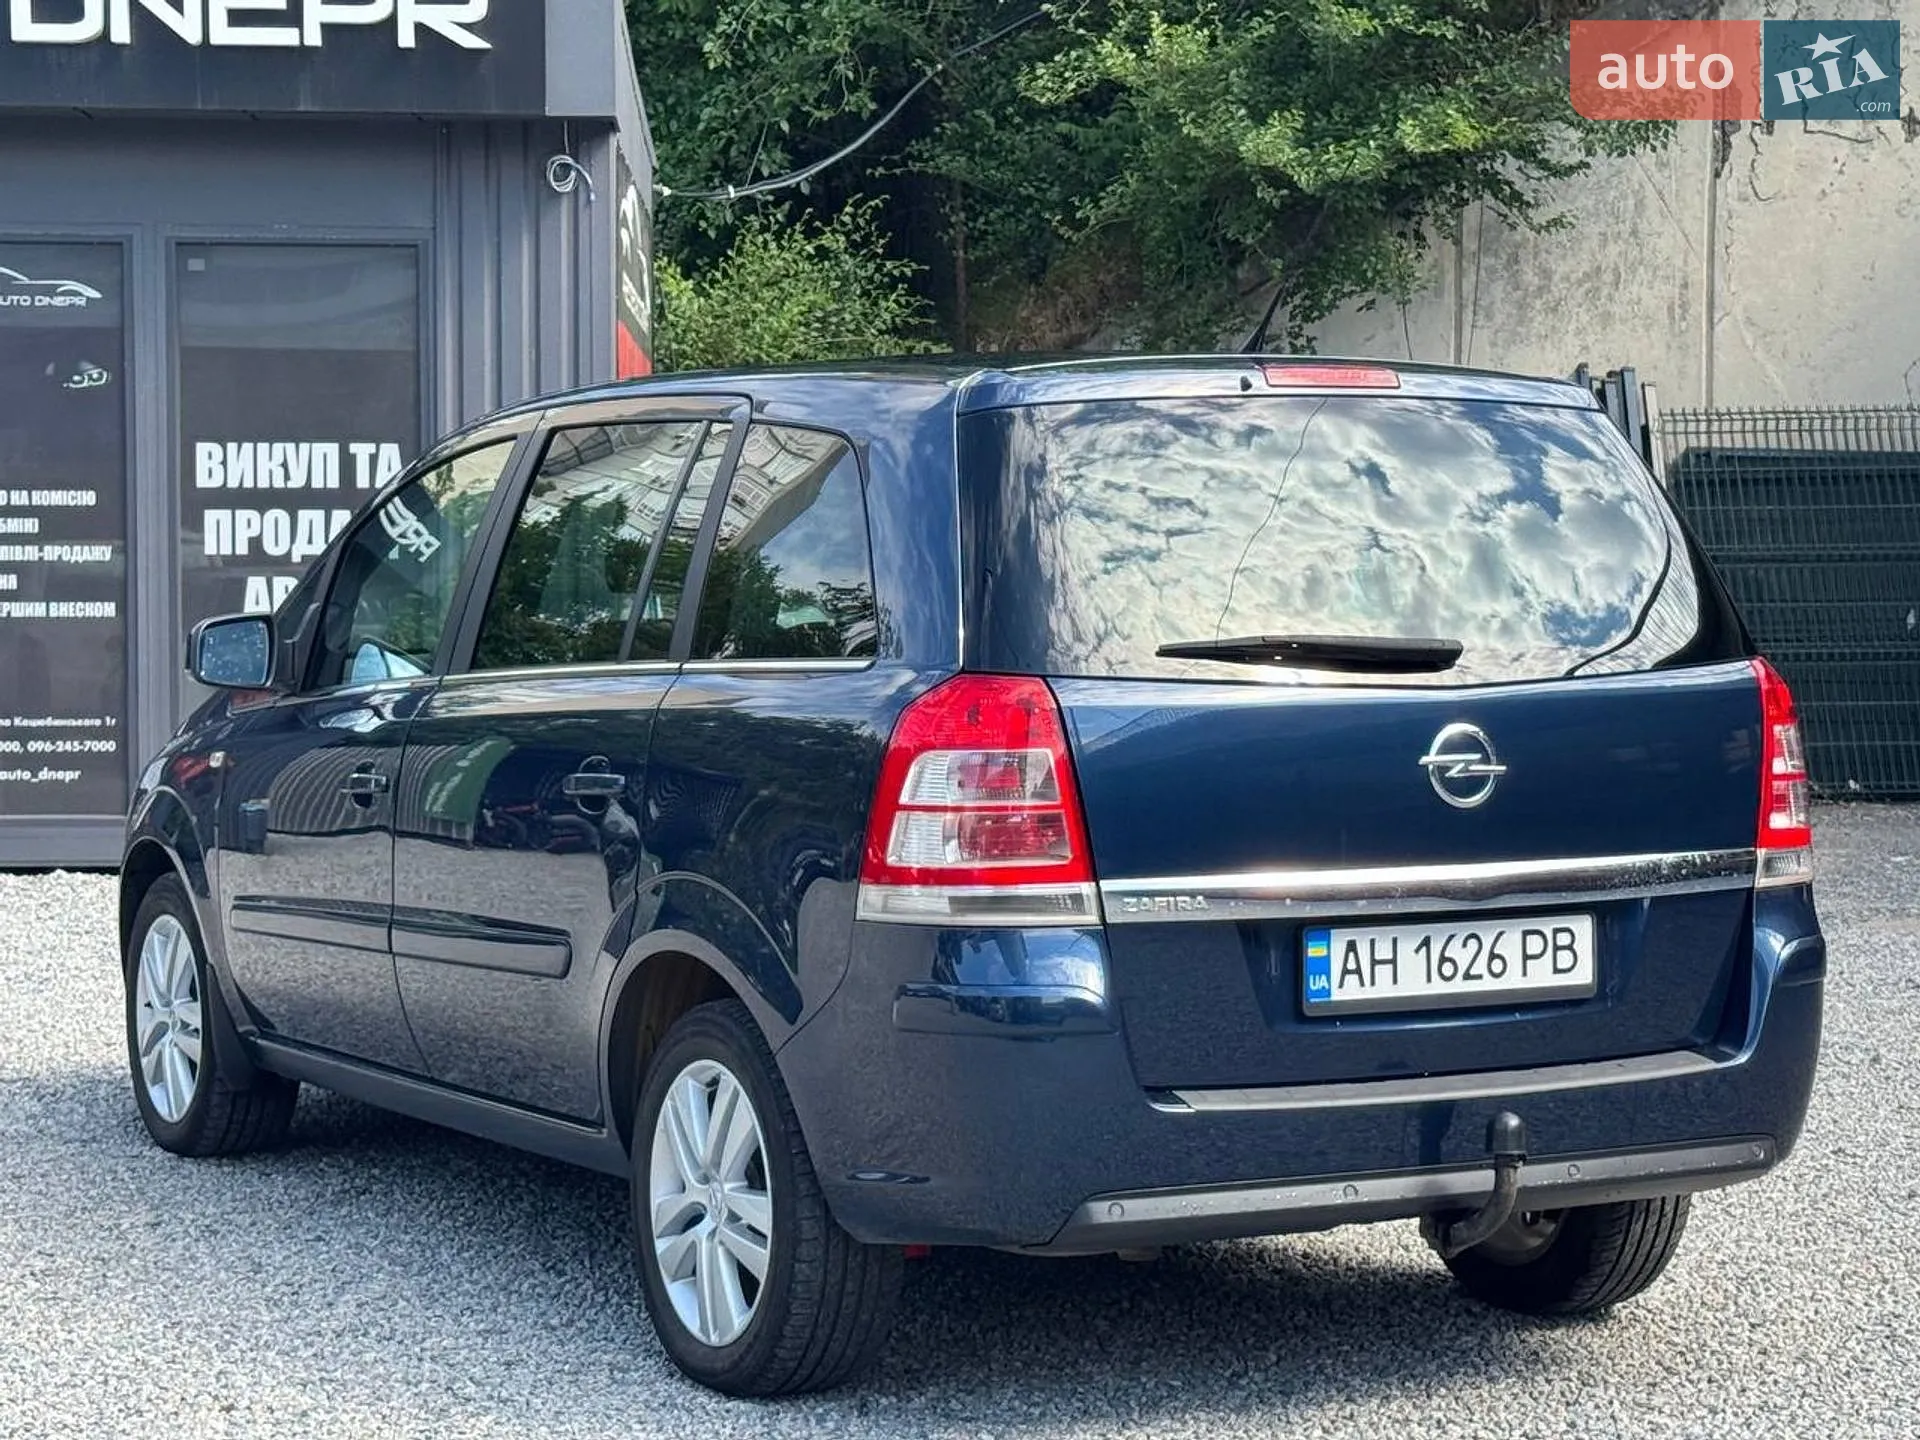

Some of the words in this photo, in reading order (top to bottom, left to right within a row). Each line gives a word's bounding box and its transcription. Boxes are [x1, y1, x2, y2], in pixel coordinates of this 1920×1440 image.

[34, 295, 87, 307] DNEPR
[195, 442, 340, 489] ВИКУП
[350, 442, 403, 489] ТА
[10, 490, 29, 506] НА
[31, 490, 97, 506] КОМІСІЮ
[48, 601, 116, 618] ВНЕСКОМ
[27, 741, 116, 753] 096-245-7000
[1122, 895, 1209, 912] ZAFIRA
[1338, 936, 1398, 989] AH
[1413, 930, 1508, 983] 1626
[1521, 926, 1578, 978] PB
[1310, 974, 1329, 990] UA
